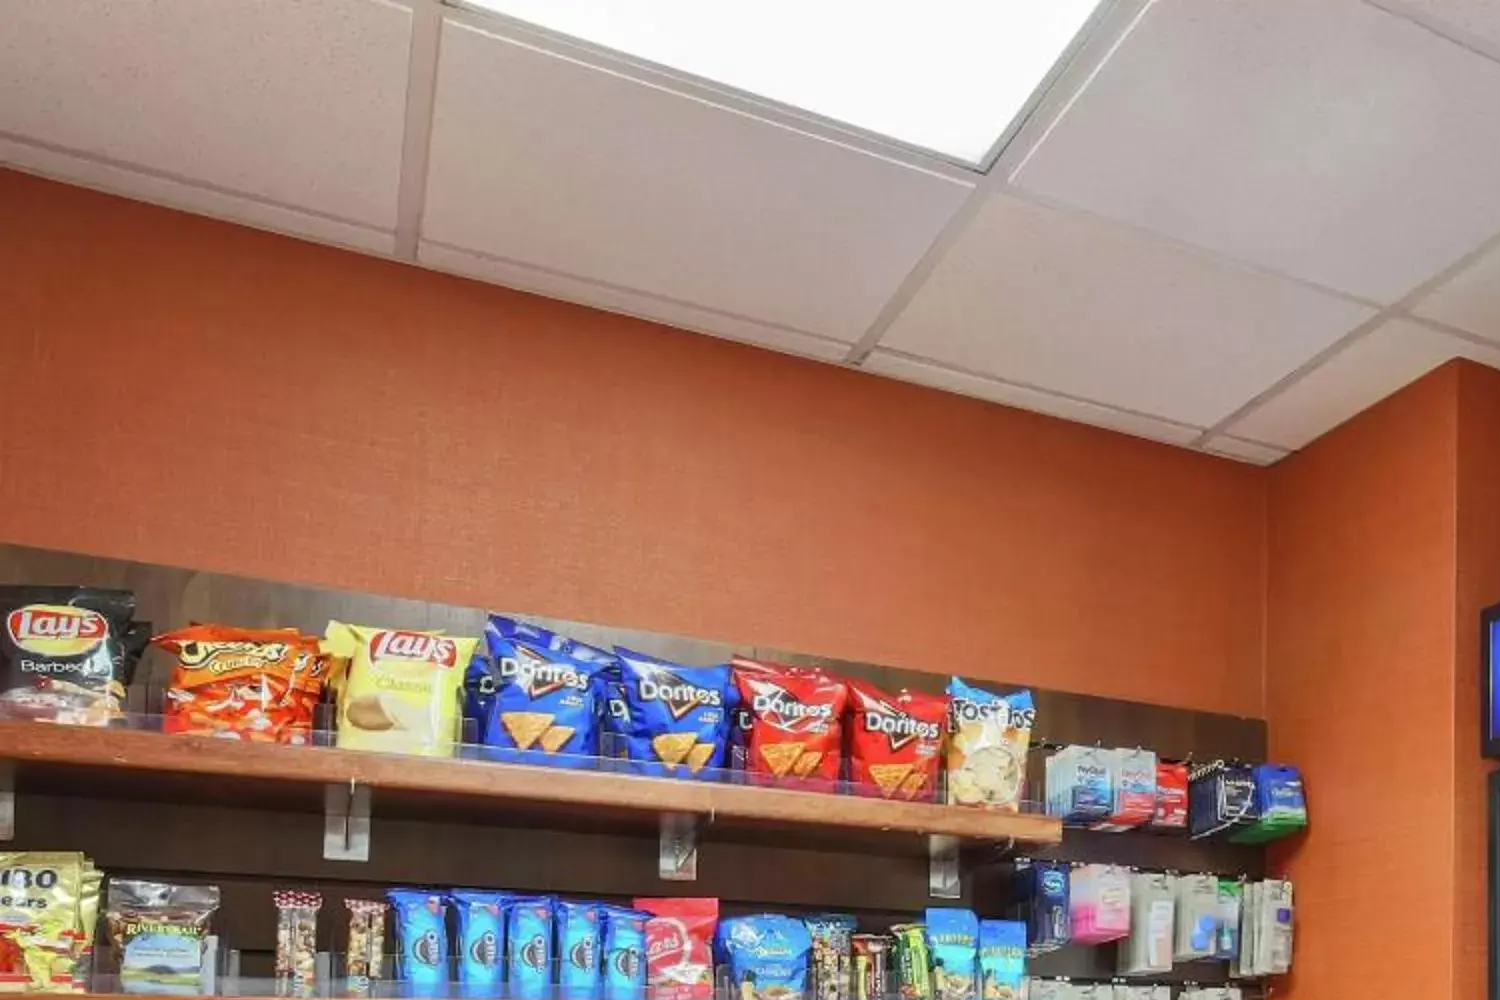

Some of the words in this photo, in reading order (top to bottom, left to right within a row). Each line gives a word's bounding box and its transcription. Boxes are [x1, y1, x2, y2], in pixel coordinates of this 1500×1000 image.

[17, 610, 99, 639] Lay's
[372, 632, 453, 665] Lay's
[501, 656, 590, 692] Doritos
[639, 678, 722, 707] Doritos
[752, 695, 834, 719] Doritos
[866, 711, 940, 739] Doritos
